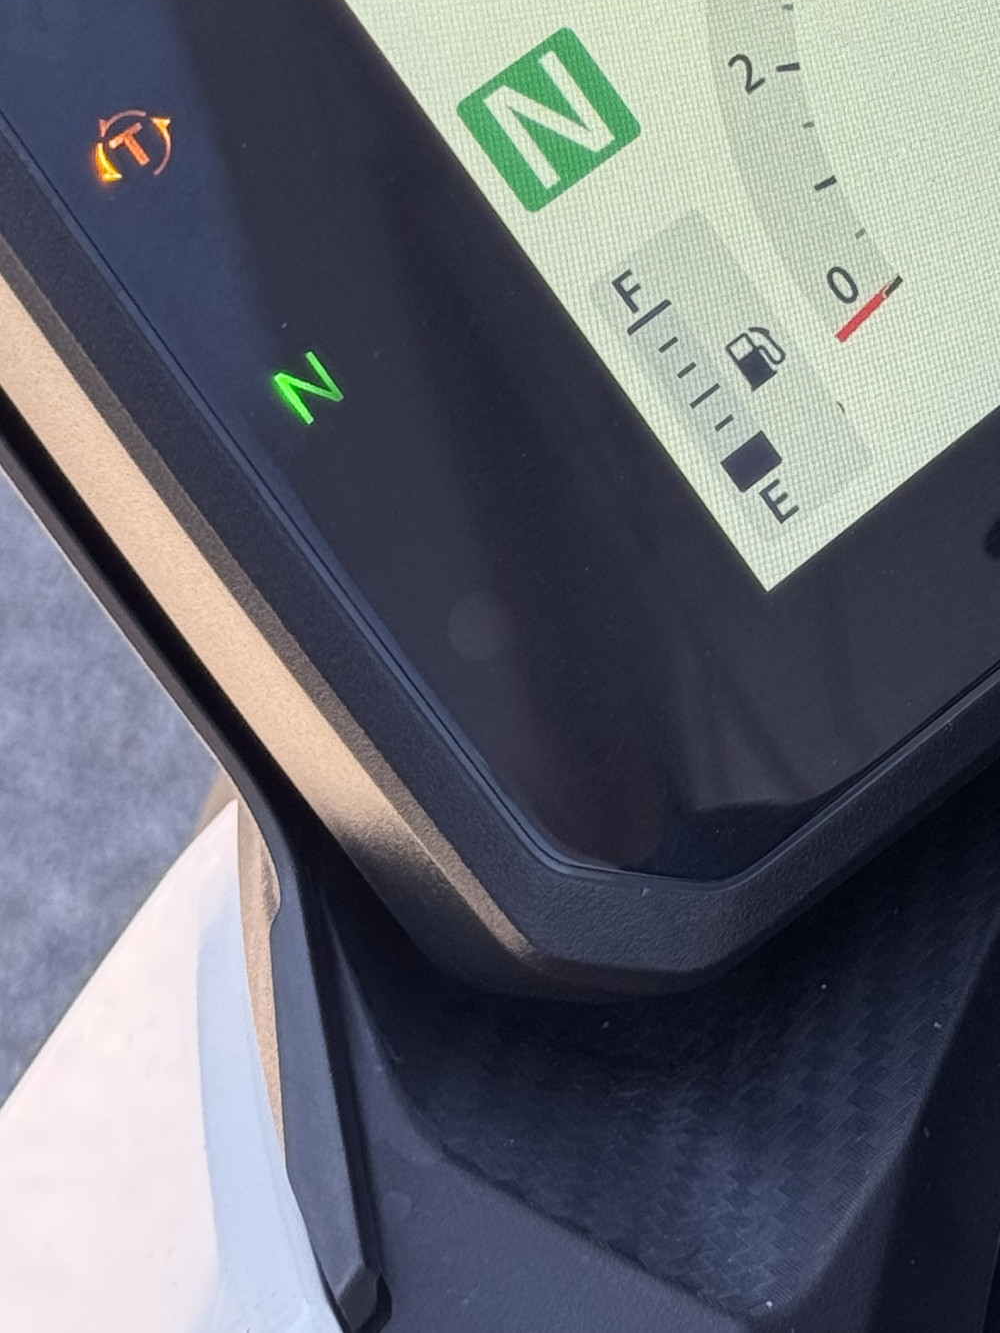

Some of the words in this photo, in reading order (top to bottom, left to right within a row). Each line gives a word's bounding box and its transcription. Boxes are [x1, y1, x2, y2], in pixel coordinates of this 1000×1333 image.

[728, 54, 766, 94] 2
[482, 50, 616, 191] N
[611, 270, 643, 313] F
[827, 266, 859, 304] 0
[273, 351, 344, 425] N
[760, 478, 800, 524] E
